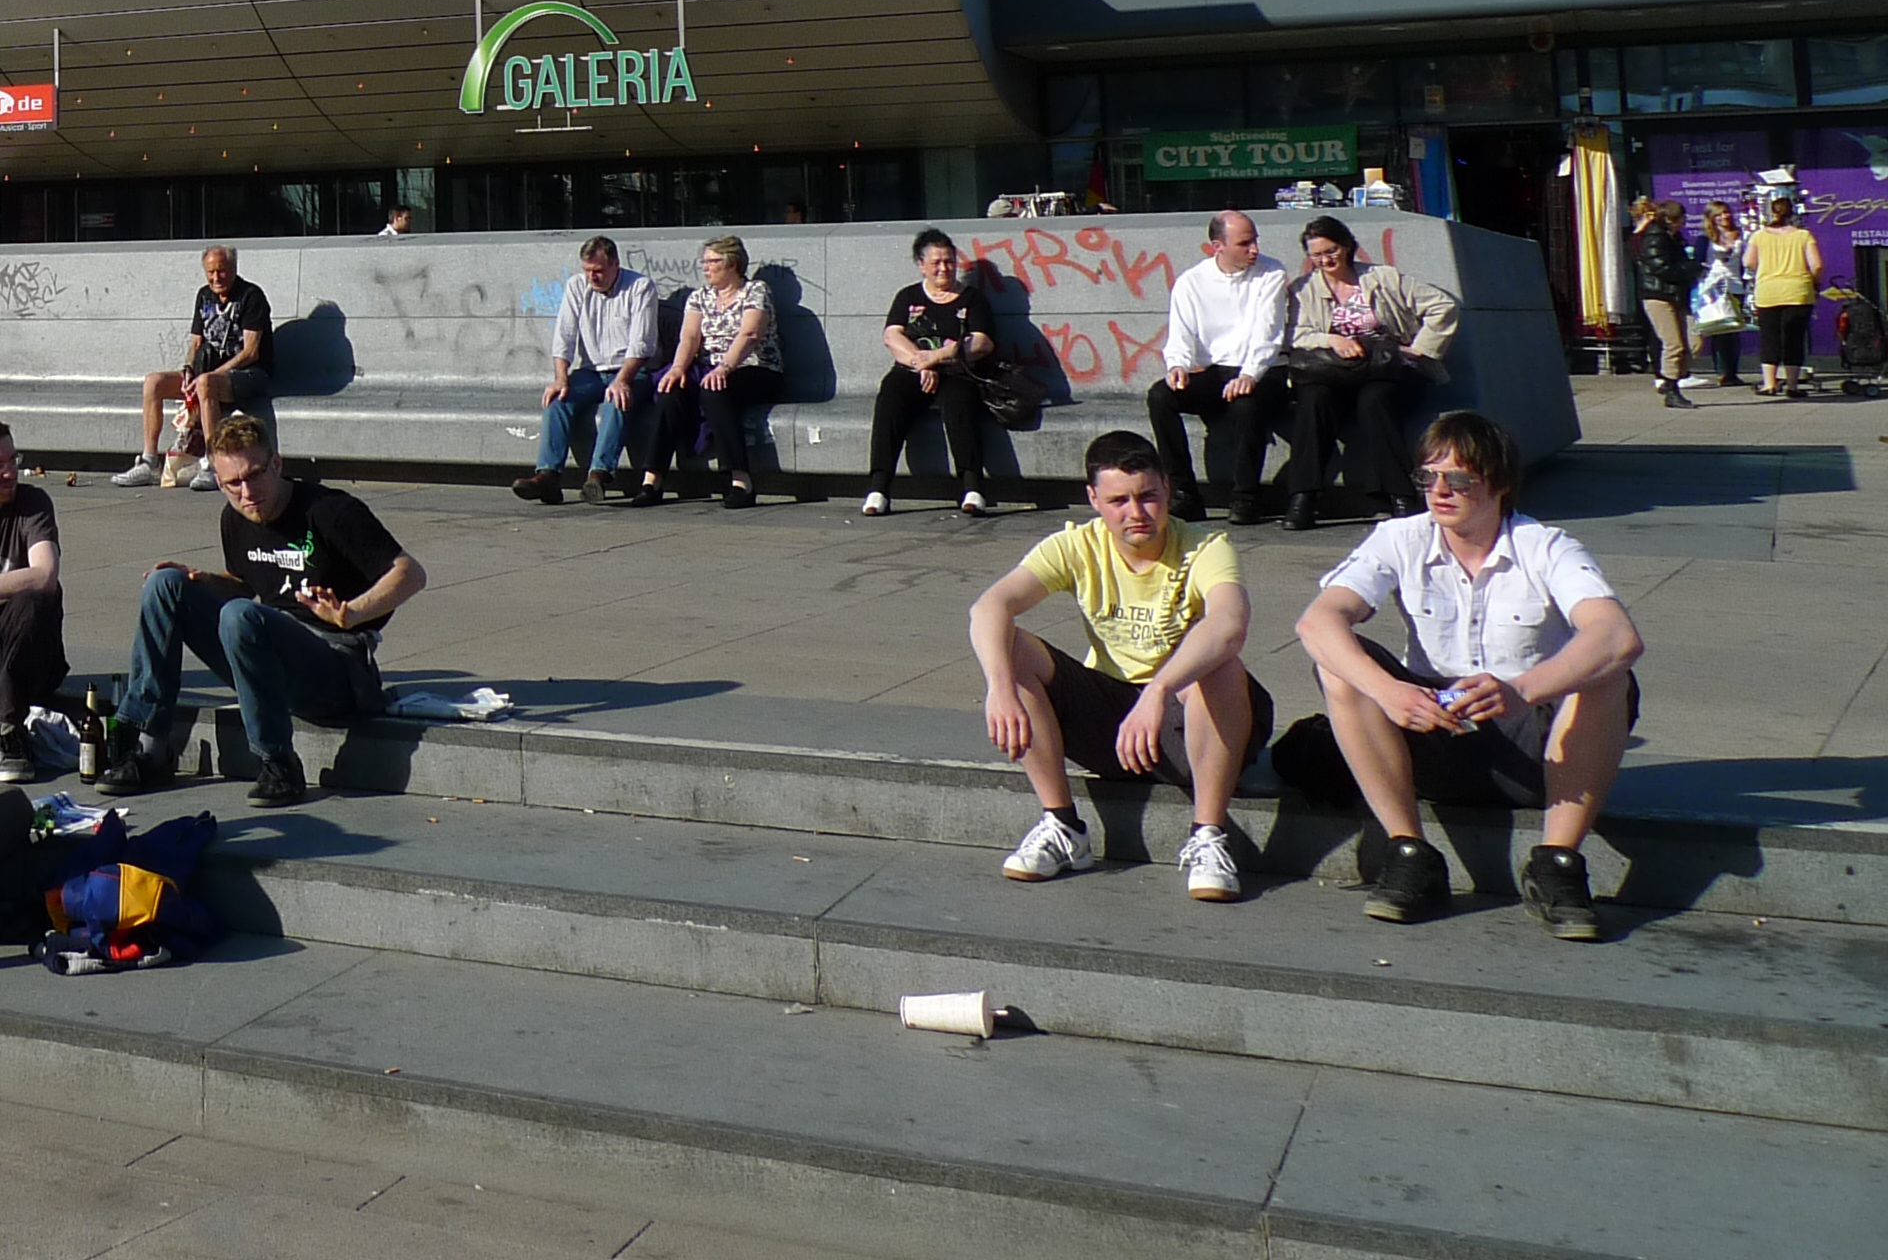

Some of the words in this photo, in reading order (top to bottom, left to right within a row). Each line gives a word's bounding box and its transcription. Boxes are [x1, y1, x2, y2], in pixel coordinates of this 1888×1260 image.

[503, 47, 698, 110] GALERIA
[1155, 144, 1238, 168] CITY
[1247, 140, 1349, 165] TOUR
[1210, 167, 1260, 178] Tickets
